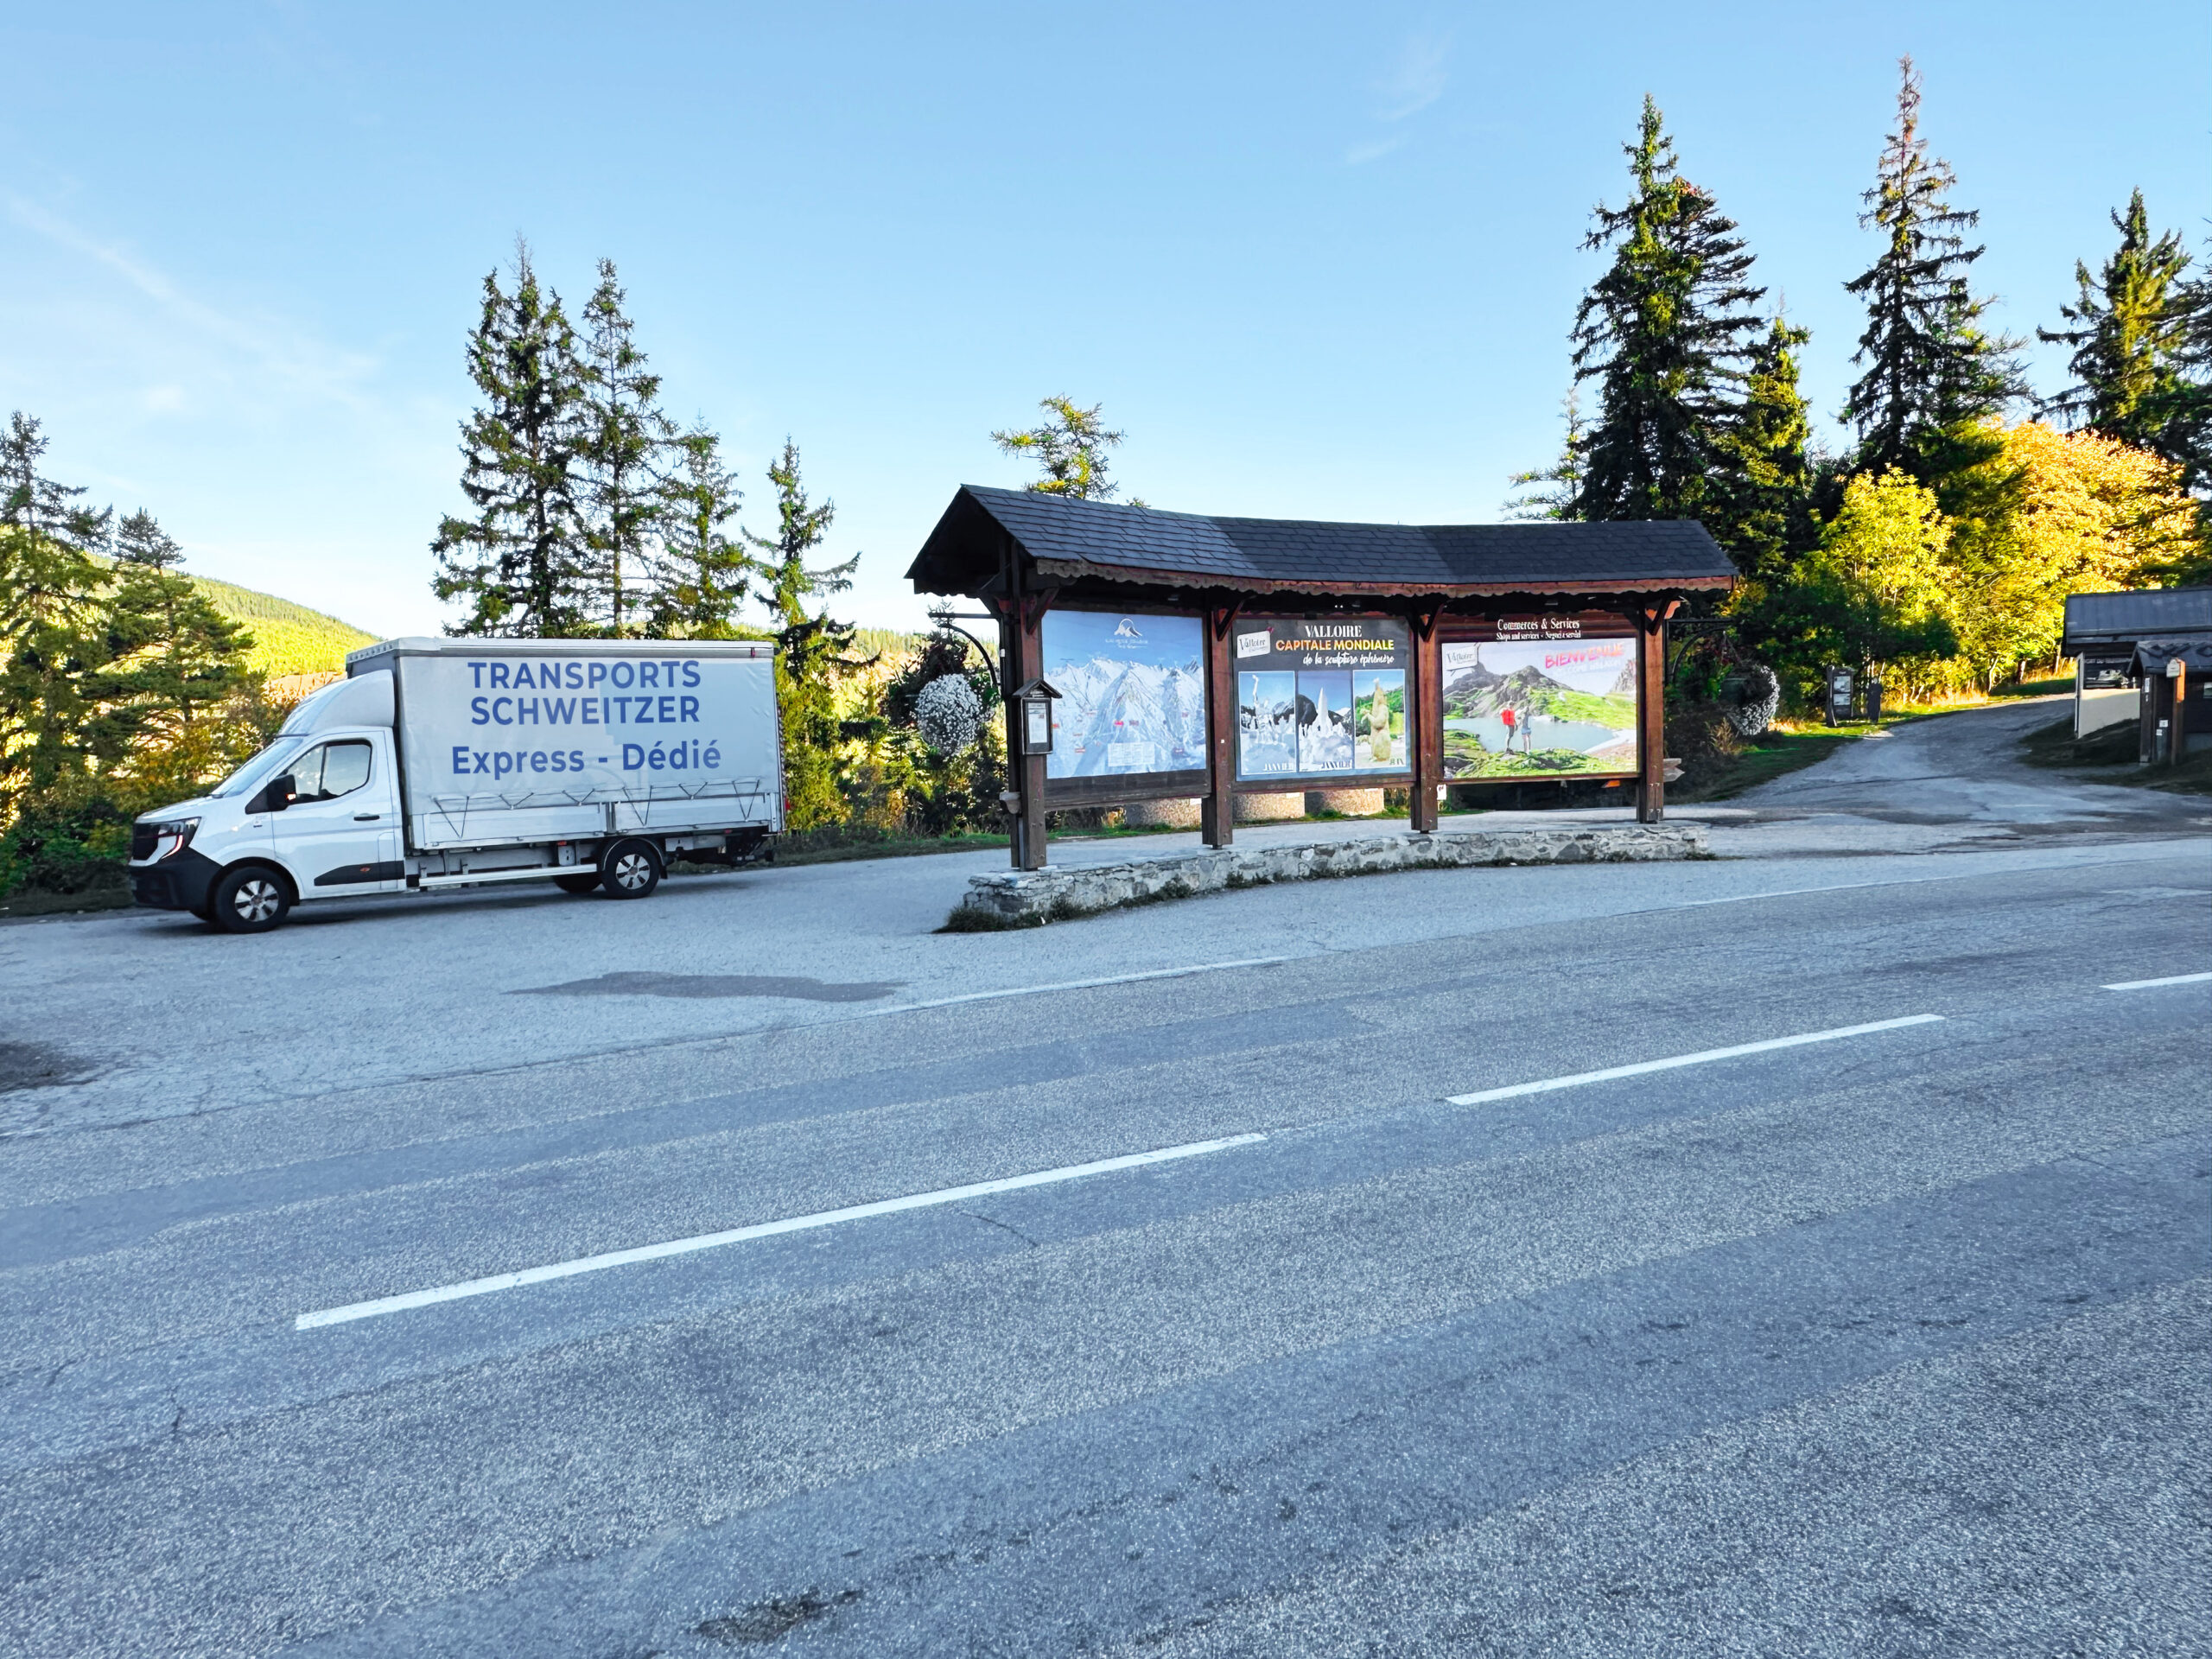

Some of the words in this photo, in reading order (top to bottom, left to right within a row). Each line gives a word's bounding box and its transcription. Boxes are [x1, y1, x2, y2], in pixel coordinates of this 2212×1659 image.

[1305, 625, 1363, 638] VALLOIRE
[1497, 619, 1538, 631] Commerces
[1541, 618, 1548, 629] &
[1551, 617, 1580, 629] Services
[1497, 632, 1510, 642] Shops
[1511, 632, 1521, 640] and
[1275, 639, 1332, 652] CAPITALE
[1333, 639, 1395, 651] MONDIALE
[1303, 652, 1313, 666] de
[1314, 652, 1322, 664] la
[1325, 652, 1358, 667] sculpture
[1545, 642, 1624, 669] BIENVENUE
[467, 660, 702, 690] TRANSPORTS
[471, 696, 700, 726] SCHWEITZER
[452, 746, 585, 780] Express
[623, 740, 721, 771] Dédié
